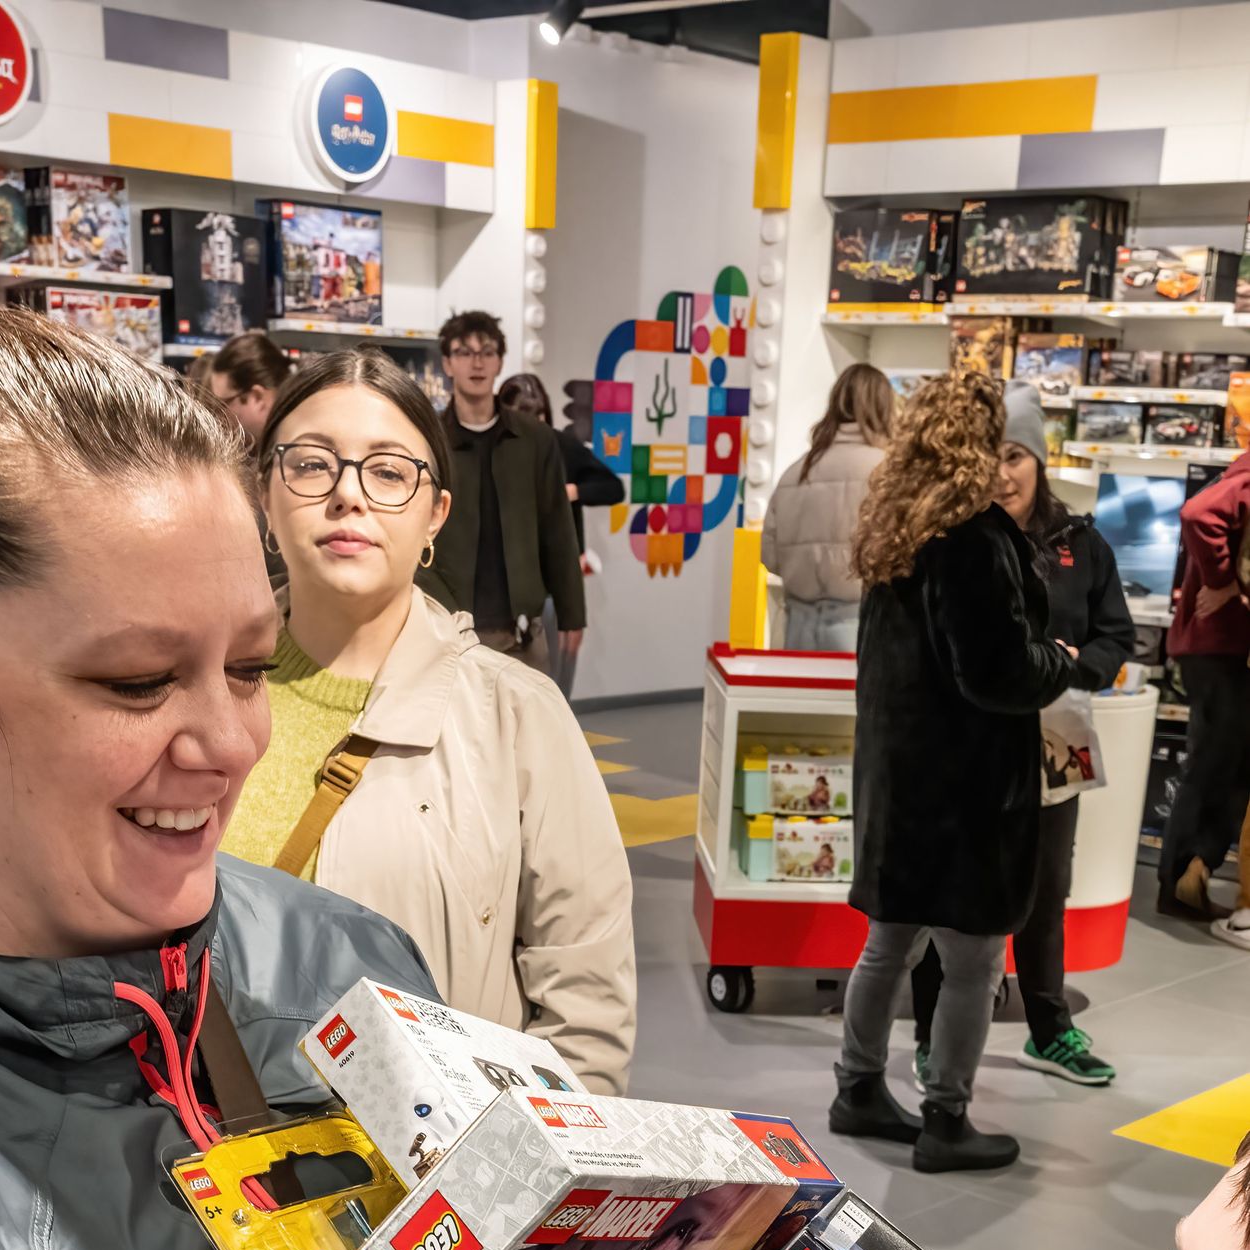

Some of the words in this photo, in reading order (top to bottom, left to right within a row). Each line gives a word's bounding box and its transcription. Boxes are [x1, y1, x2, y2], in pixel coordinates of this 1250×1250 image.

[325, 1019, 347, 1049] LEGO
[338, 1050, 356, 1068] 40619
[189, 1176, 212, 1191] LEGO
[205, 1205, 223, 1219] 6+
[543, 1204, 595, 1229] LEGO
[580, 1199, 677, 1239] MARVEL
